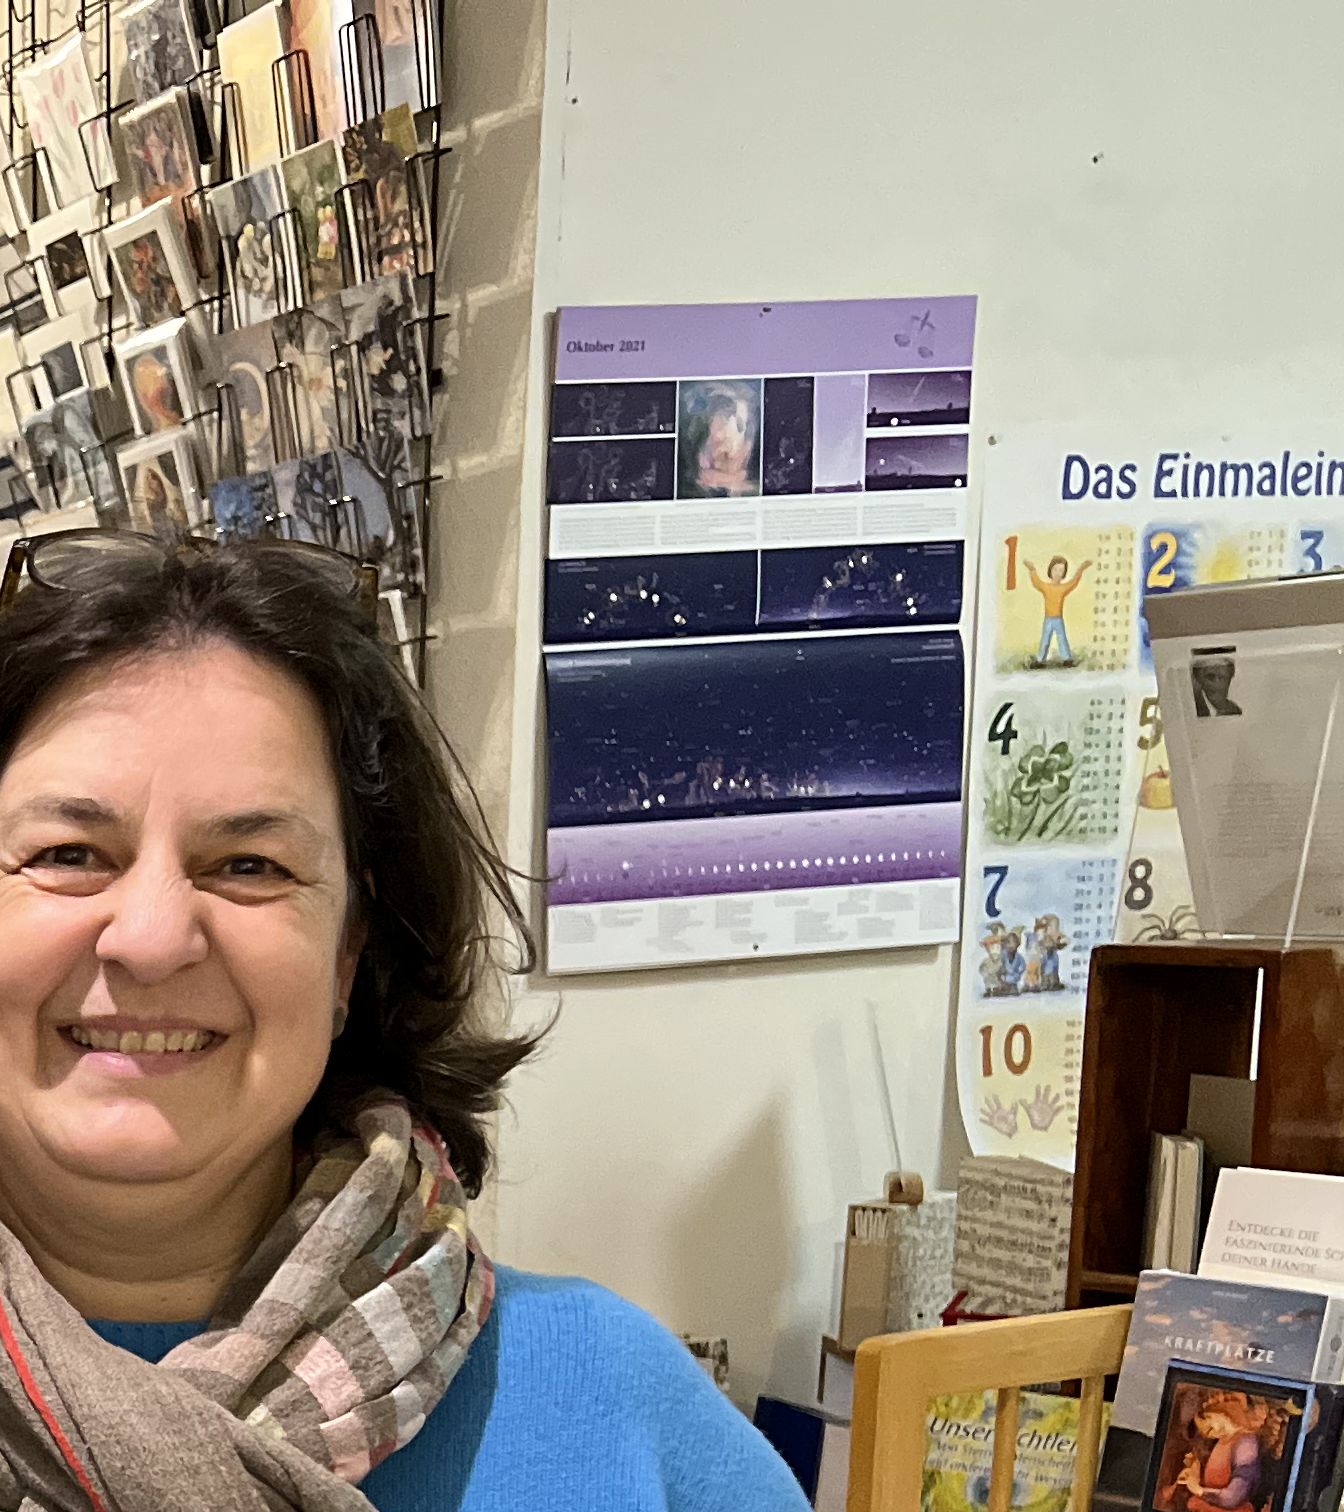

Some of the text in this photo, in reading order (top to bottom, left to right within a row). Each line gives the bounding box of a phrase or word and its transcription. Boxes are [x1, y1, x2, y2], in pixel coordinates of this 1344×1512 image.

[566, 339, 646, 353] Oktober 2021
[1061, 453, 1138, 500] Das
[1004, 535, 1019, 591] 1
[1145, 532, 1178, 588] 2
[987, 697, 1162, 756] 4 5
[983, 857, 1153, 918] 7 8
[978, 1022, 1033, 1077] 10
[1224, 1235, 1321, 1258] FASZINIERENDE
[1228, 1219, 1320, 1242] ENTDECKE DIE
[1220, 1251, 1268, 1268] DEINER
[1164, 1333, 1276, 1365] KRAFTPLÄTZE
